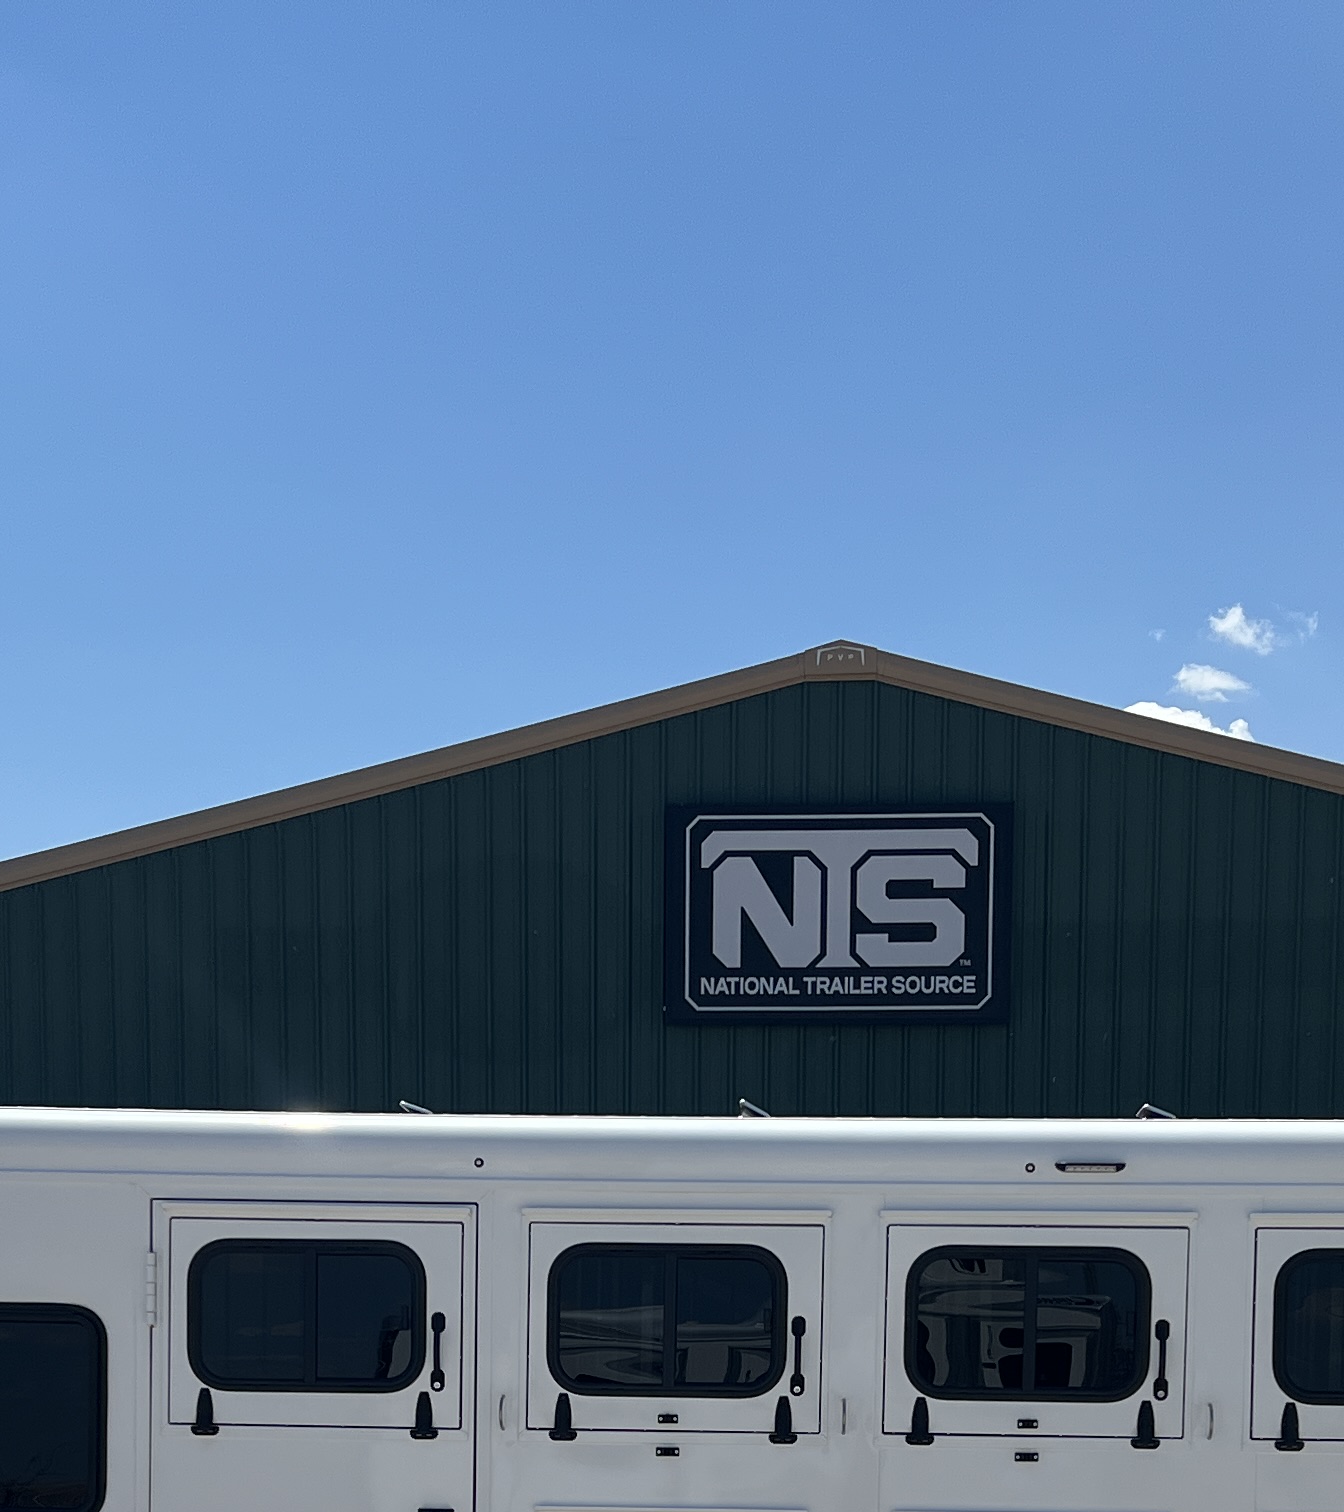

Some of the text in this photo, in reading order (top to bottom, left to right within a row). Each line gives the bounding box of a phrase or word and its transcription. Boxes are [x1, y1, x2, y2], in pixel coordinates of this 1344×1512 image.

[701, 828, 979, 969] NTS
[700, 975, 977, 996] NATIONAL TRAILER SOURCE
